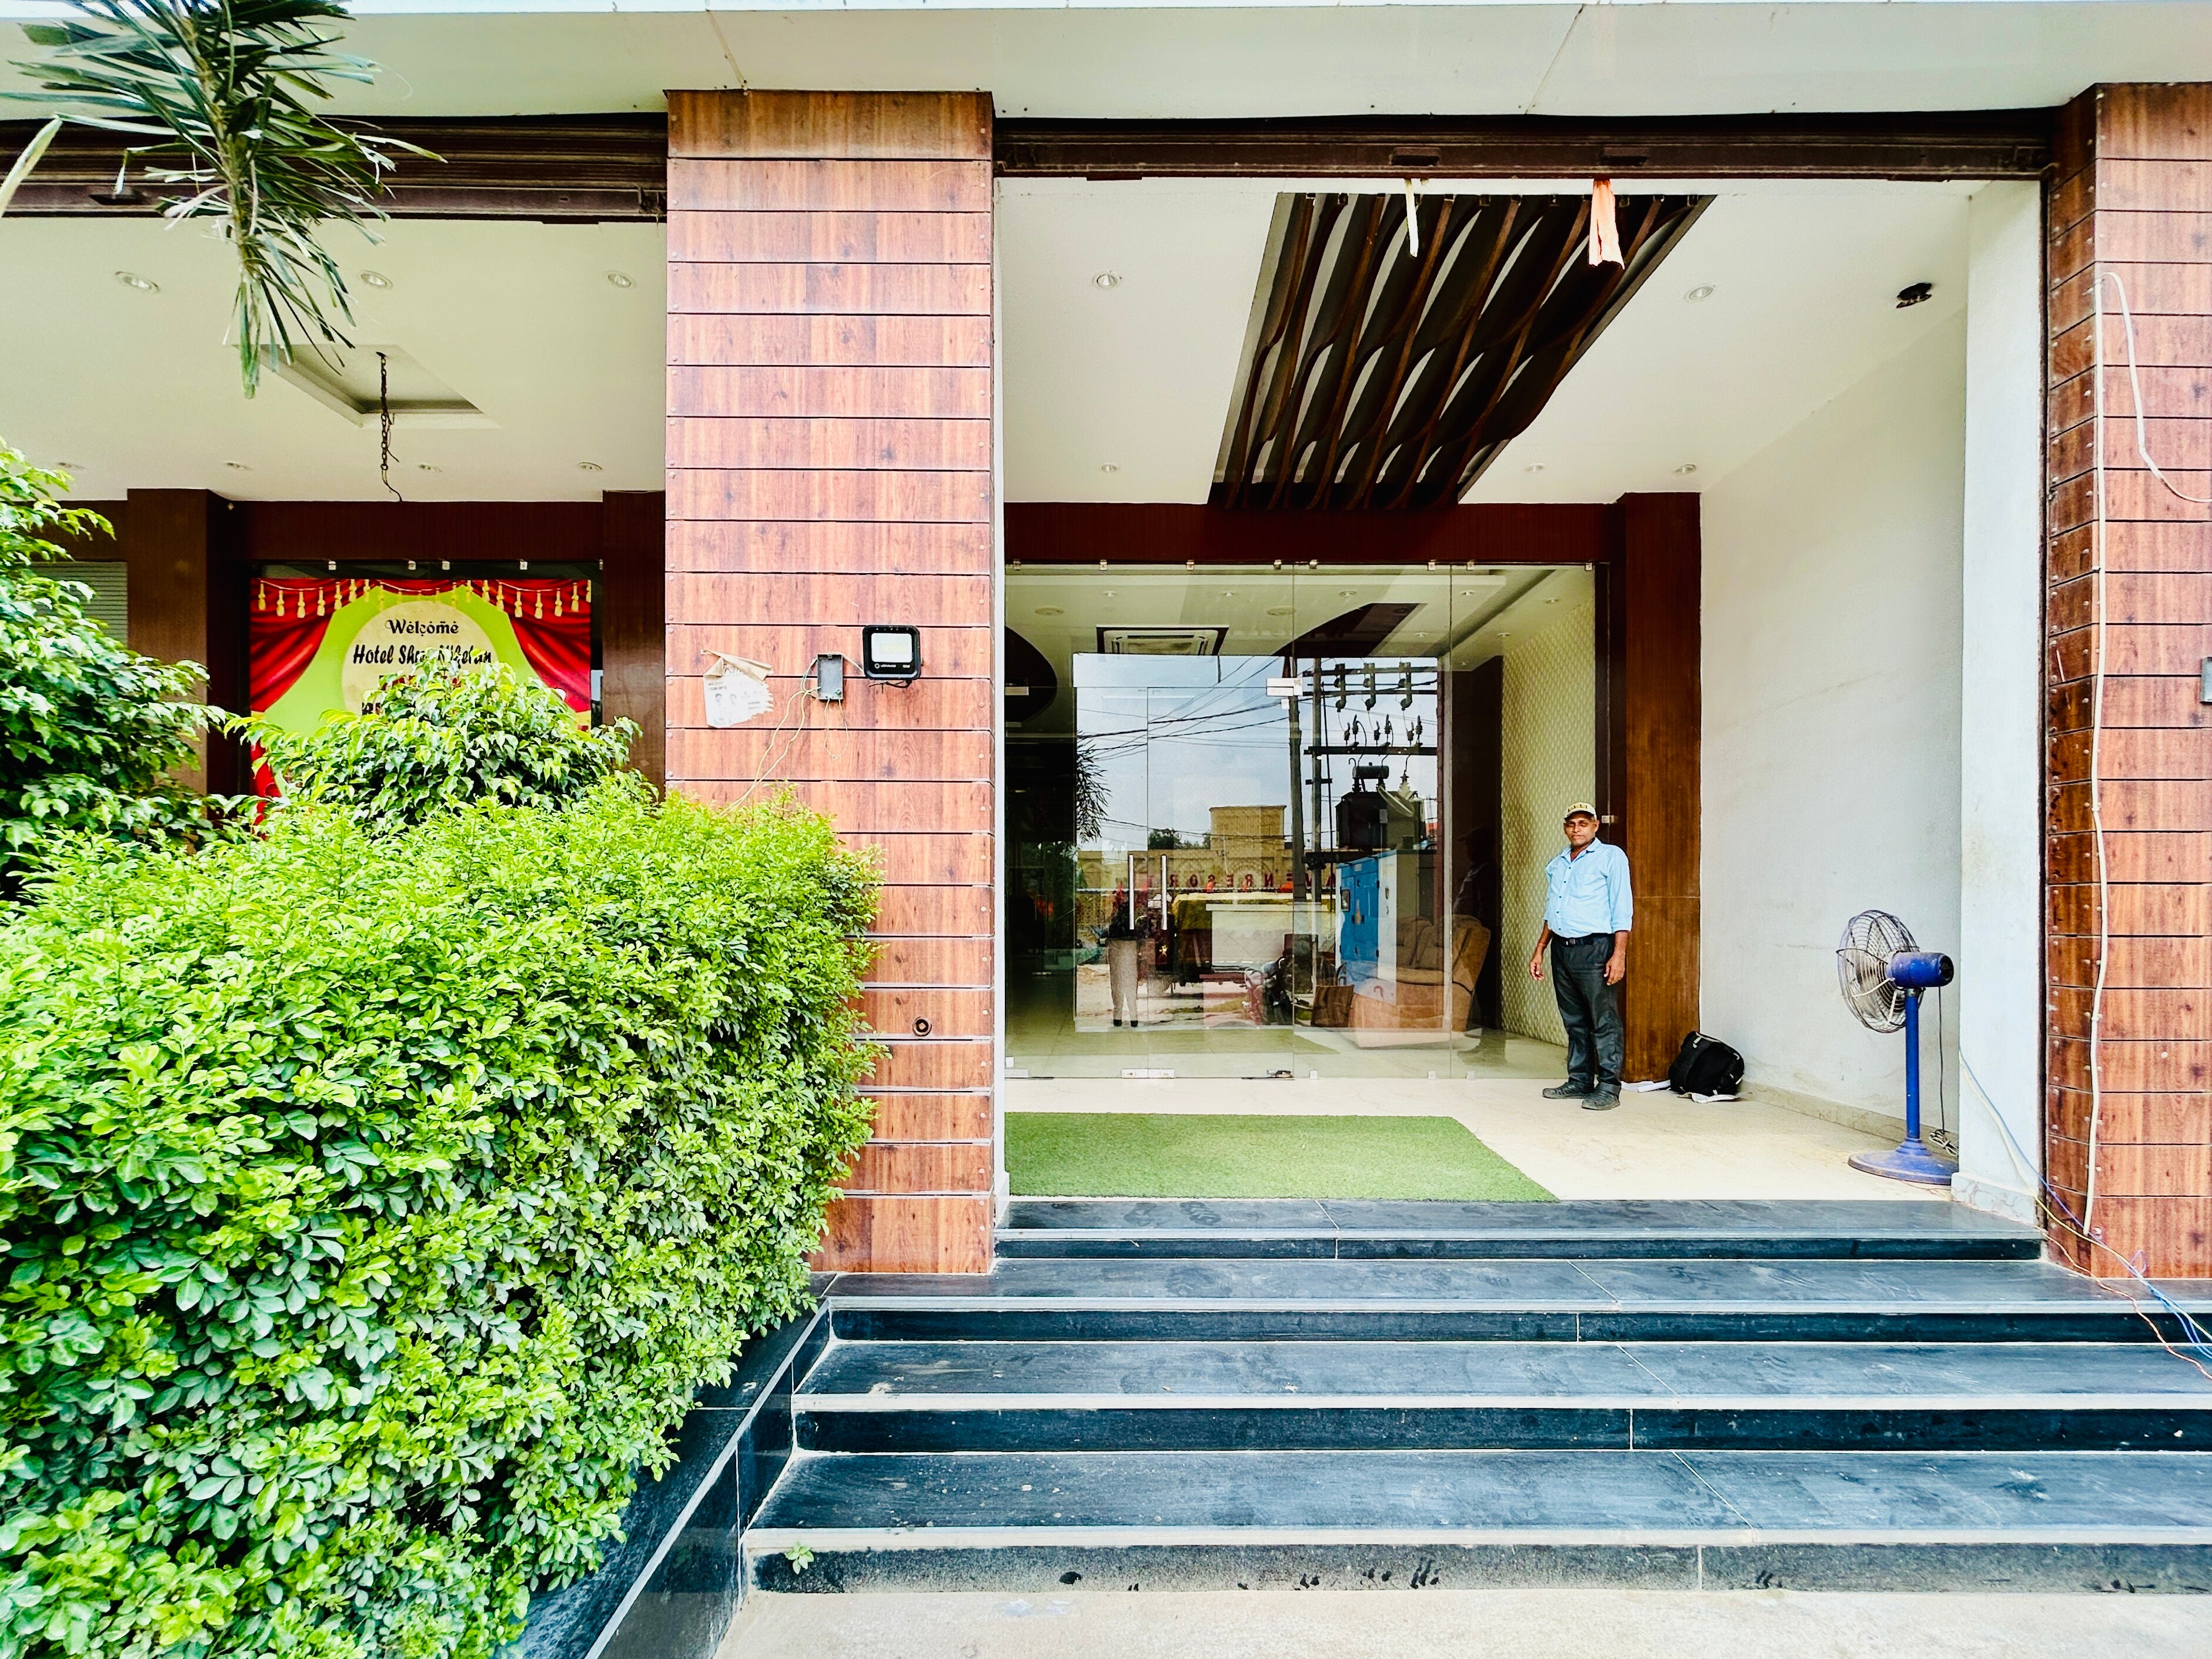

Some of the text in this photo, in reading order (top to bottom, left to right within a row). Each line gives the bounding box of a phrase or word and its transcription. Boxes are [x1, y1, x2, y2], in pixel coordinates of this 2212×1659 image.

[385, 619, 459, 636] Welcome
[353, 644, 394, 664] Hotel
[399, 645, 427, 664] Shr
